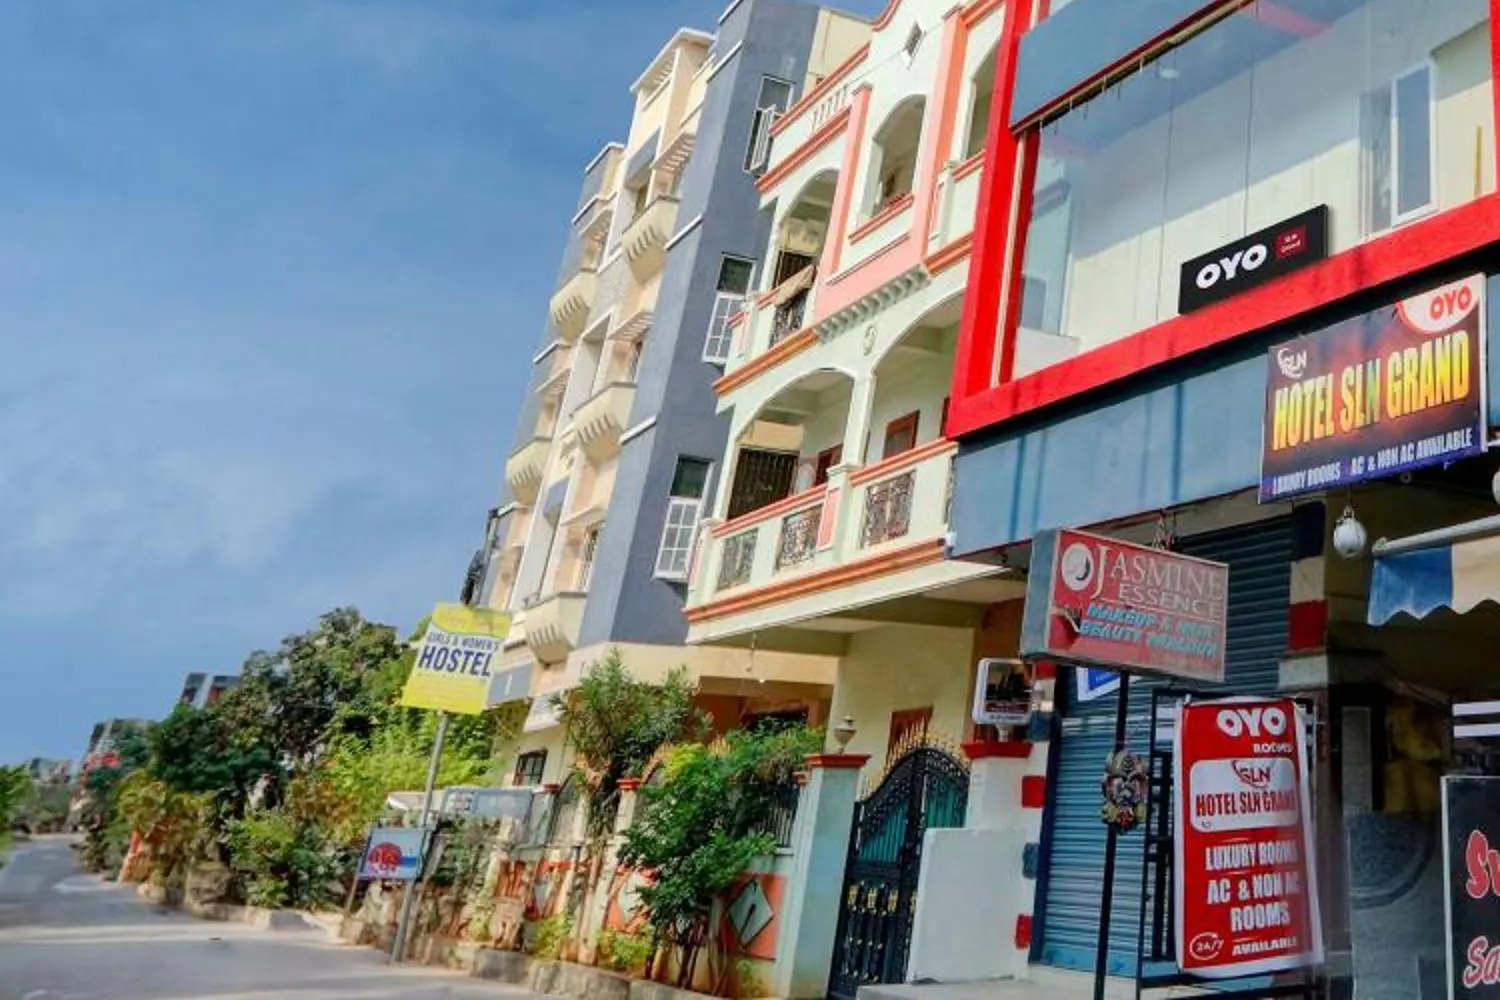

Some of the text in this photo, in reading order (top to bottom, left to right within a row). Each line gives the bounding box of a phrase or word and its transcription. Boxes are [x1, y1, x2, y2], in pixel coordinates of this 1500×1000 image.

[1195, 243, 1268, 289] OYO
[1429, 286, 1473, 321] OYO
[1273, 329, 1470, 451] HOTEL SLN GRAND
[1351, 455, 1365, 477] AC
[1416, 427, 1474, 459] AVAILABLE
[1090, 543, 1224, 600] JASMINE
[1118, 582, 1223, 619] ESSENCE
[418, 645, 493, 677] HOSTEL
[1216, 707, 1287, 737] OYO
[1196, 793, 1237, 817] HOTEL
[1205, 841, 1257, 872] LUXURY
[1207, 878, 1231, 904] AC
[1238, 879, 1249, 901] &
[1253, 871, 1282, 898] NON
[1230, 900, 1291, 932] ROOMS
[1195, 939, 1224, 953] 24/7
